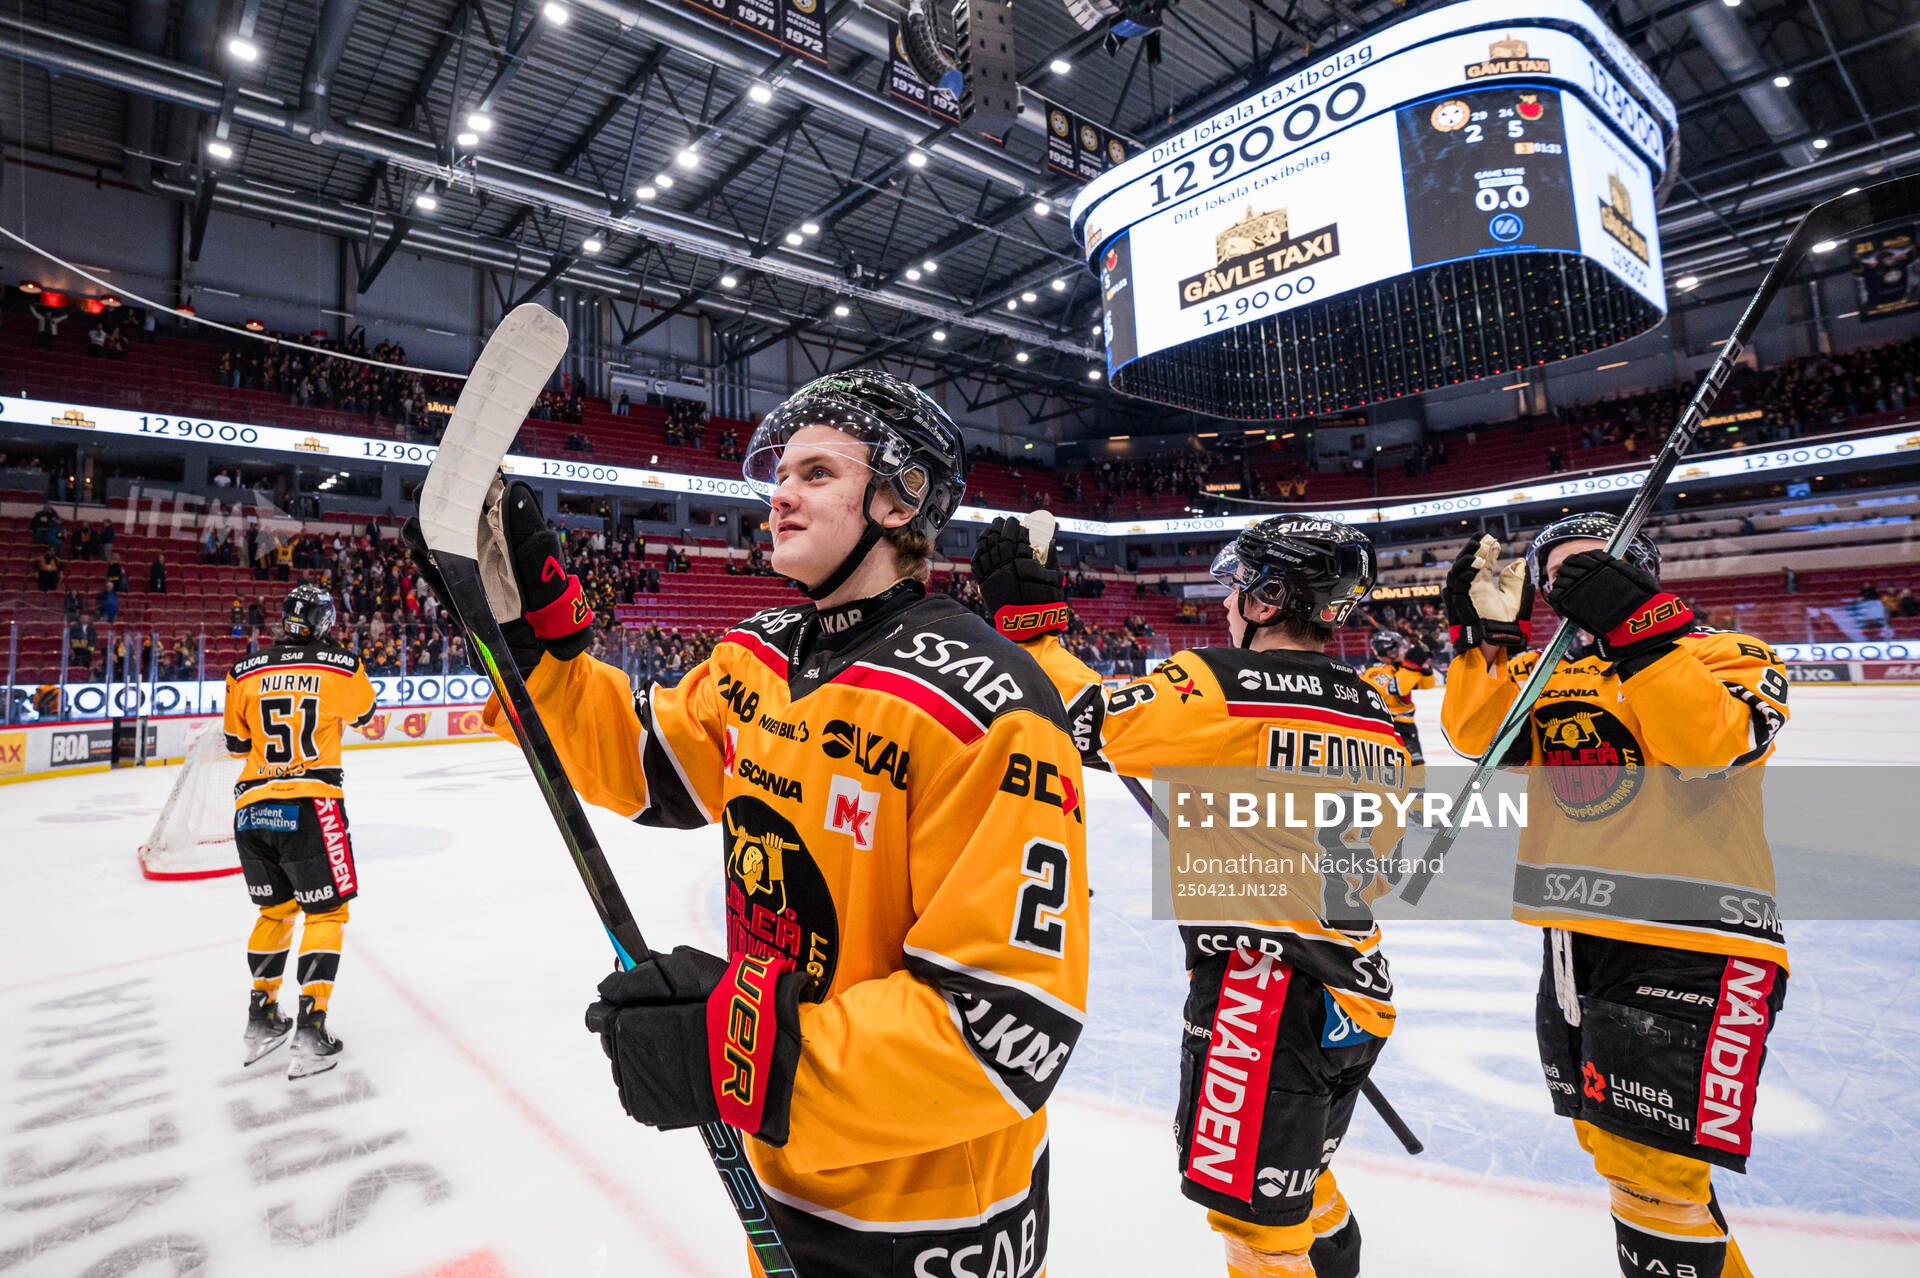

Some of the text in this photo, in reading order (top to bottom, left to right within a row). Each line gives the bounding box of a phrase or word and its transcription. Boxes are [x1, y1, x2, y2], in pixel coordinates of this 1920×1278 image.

[737, 5, 776, 31] 1971
[785, 26, 824, 53] 1972
[1467, 59, 1549, 78] GÄVLE TAXI
[892, 76, 926, 100] 1976
[1152, 44, 1374, 164] Ditt lokala taxibolag
[1471, 110, 1488, 122] 29
[1464, 119, 1524, 143] 2 5
[1173, 150, 1331, 225] Ditt lokala taxibolag
[1475, 184, 1530, 211] 0.0
[1184, 232, 1334, 302] GÄVLE TAXI
[1290, 520, 1333, 534] LKAB
[242, 652, 355, 671] LKAB SSAB LKAB
[894, 631, 1024, 713] SSAB
[259, 674, 321, 695] NURMI
[1263, 672, 1360, 703] LKAB SSAB
[259, 695, 320, 766] 51
[52, 732, 91, 763] BOA
[1266, 726, 1407, 791] HEDQVIST
[1621, 747, 1640, 777] 1977
[738, 758, 804, 804] SCANIA
[250, 806, 283, 818] Student
[250, 815, 297, 830] Consulting
[321, 814, 354, 893] NÅIDEN
[300, 885, 335, 904] LKAB
[1009, 836, 1070, 960] 2
[1543, 873, 1616, 907] SSAB
[1635, 985, 1716, 1008] BAUER
[1700, 959, 1767, 1145] NÅIDEN
[1192, 986, 1263, 1185] NÅIDEN
[1610, 1073, 1674, 1109] Luleå
[1612, 1091, 1691, 1133] Energi
